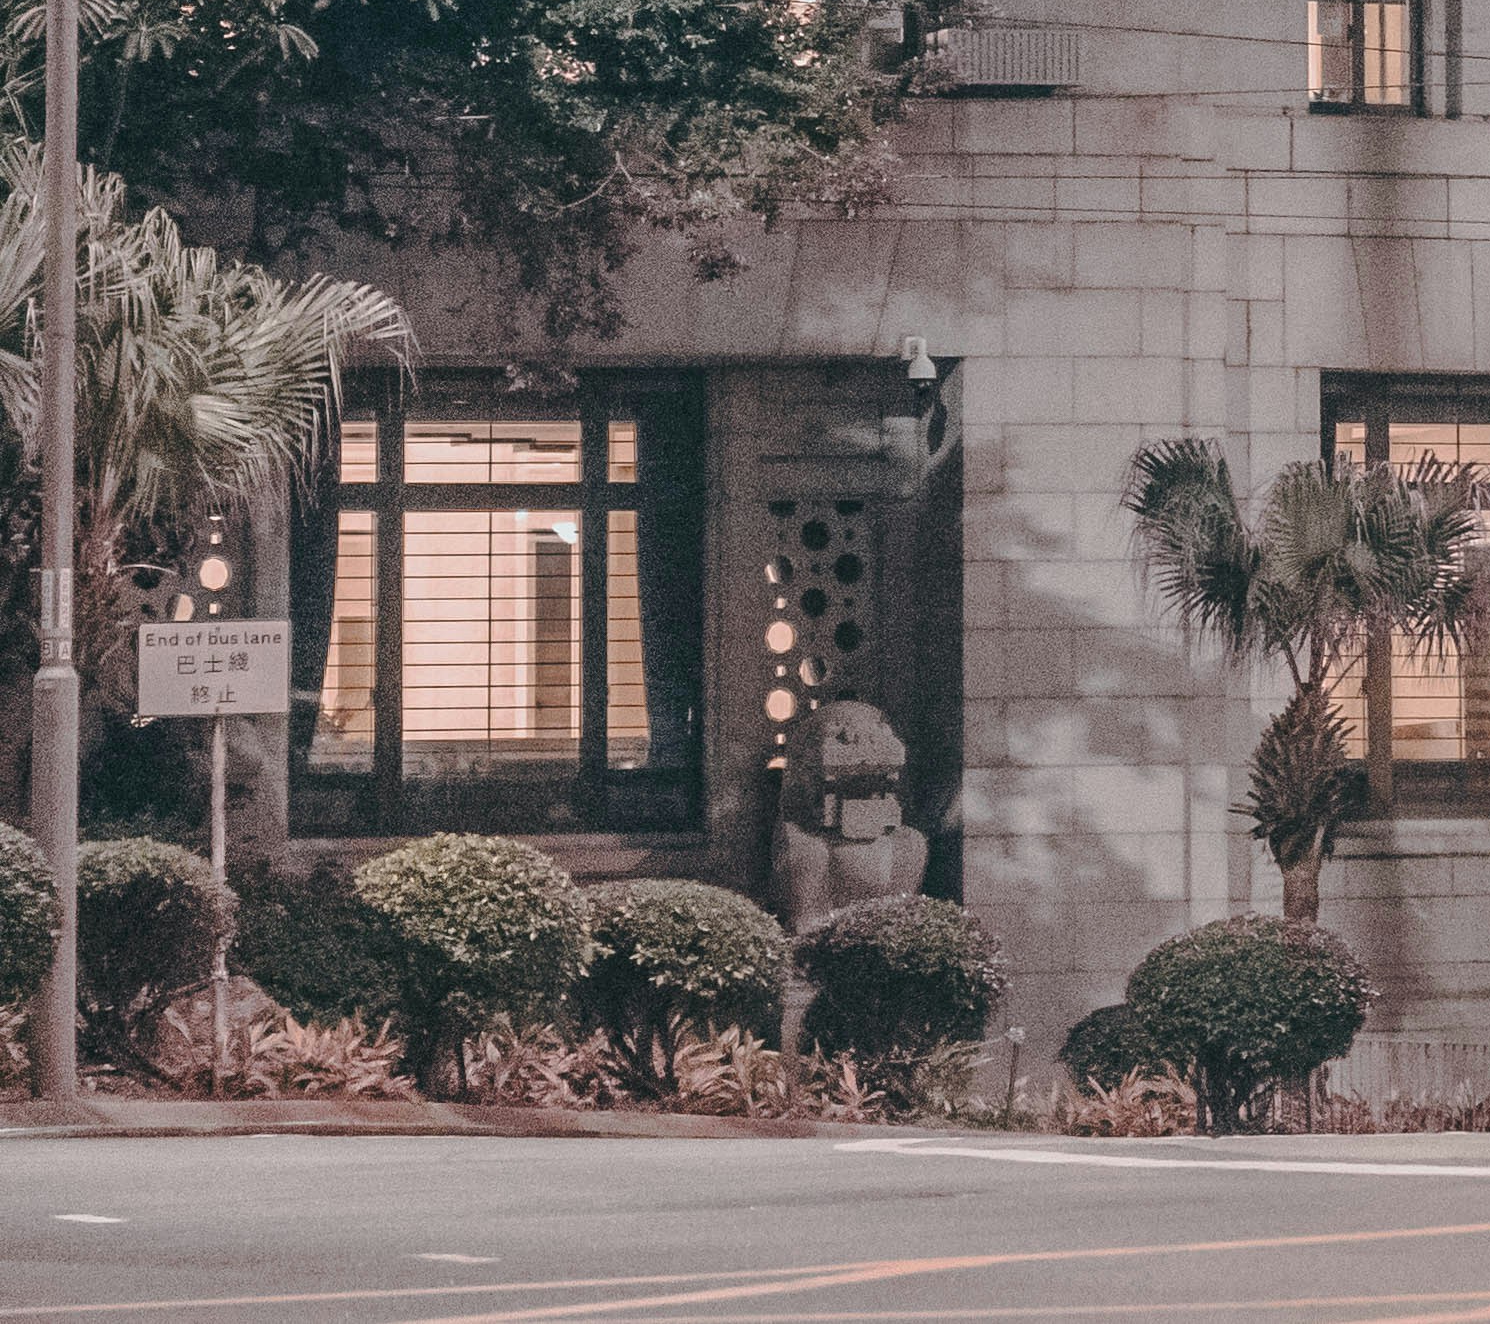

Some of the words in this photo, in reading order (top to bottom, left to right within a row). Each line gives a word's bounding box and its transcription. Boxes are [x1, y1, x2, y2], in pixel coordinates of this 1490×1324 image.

[145, 632, 179, 647] End
[185, 632, 201, 646] of
[208, 632, 238, 645] bus
[244, 631, 282, 645] lane
[190, 683, 238, 704] 終止
